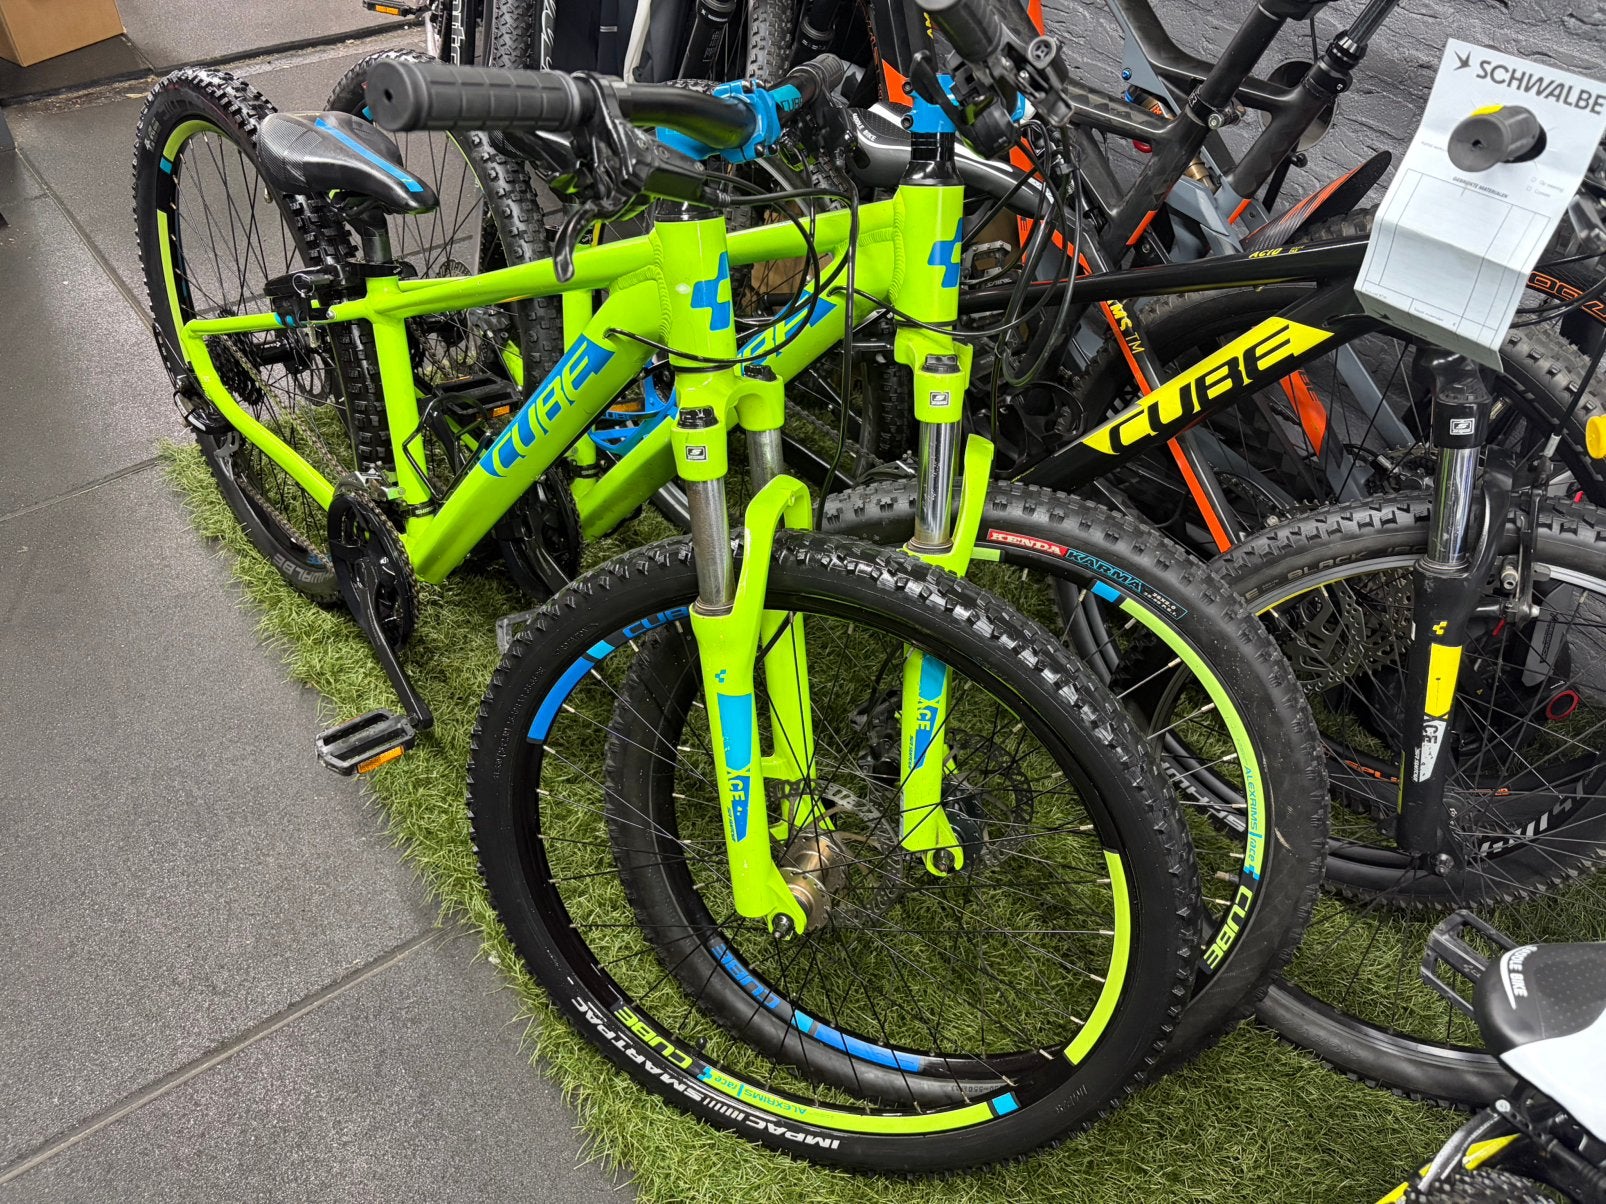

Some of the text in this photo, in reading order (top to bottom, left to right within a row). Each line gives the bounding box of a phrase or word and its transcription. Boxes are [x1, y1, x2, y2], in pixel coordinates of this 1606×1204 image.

[1475, 59, 1606, 115] SCHWALBE
[1249, 247, 1283, 259] ACID
[492, 340, 590, 478] CUBE
[1108, 323, 1291, 454] CUBE
[991, 532, 1143, 592] KENDA KARMA
[1287, 551, 1369, 581] BLACK
[622, 606, 690, 638] CUB
[917, 696, 941, 732] XCE
[726, 764, 751, 801] XCE
[1243, 765, 1259, 831] ALEXRIMS
[1203, 885, 1253, 970] CUBE
[711, 943, 782, 1009] CUBE
[1509, 972, 1529, 998] BIKE
[571, 996, 705, 1103] SMARTPAC
[614, 1005, 694, 1070] CUBE
[713, 1075, 808, 1117] race ALEXRIMS
[744, 1115, 841, 1151] IMPAC
